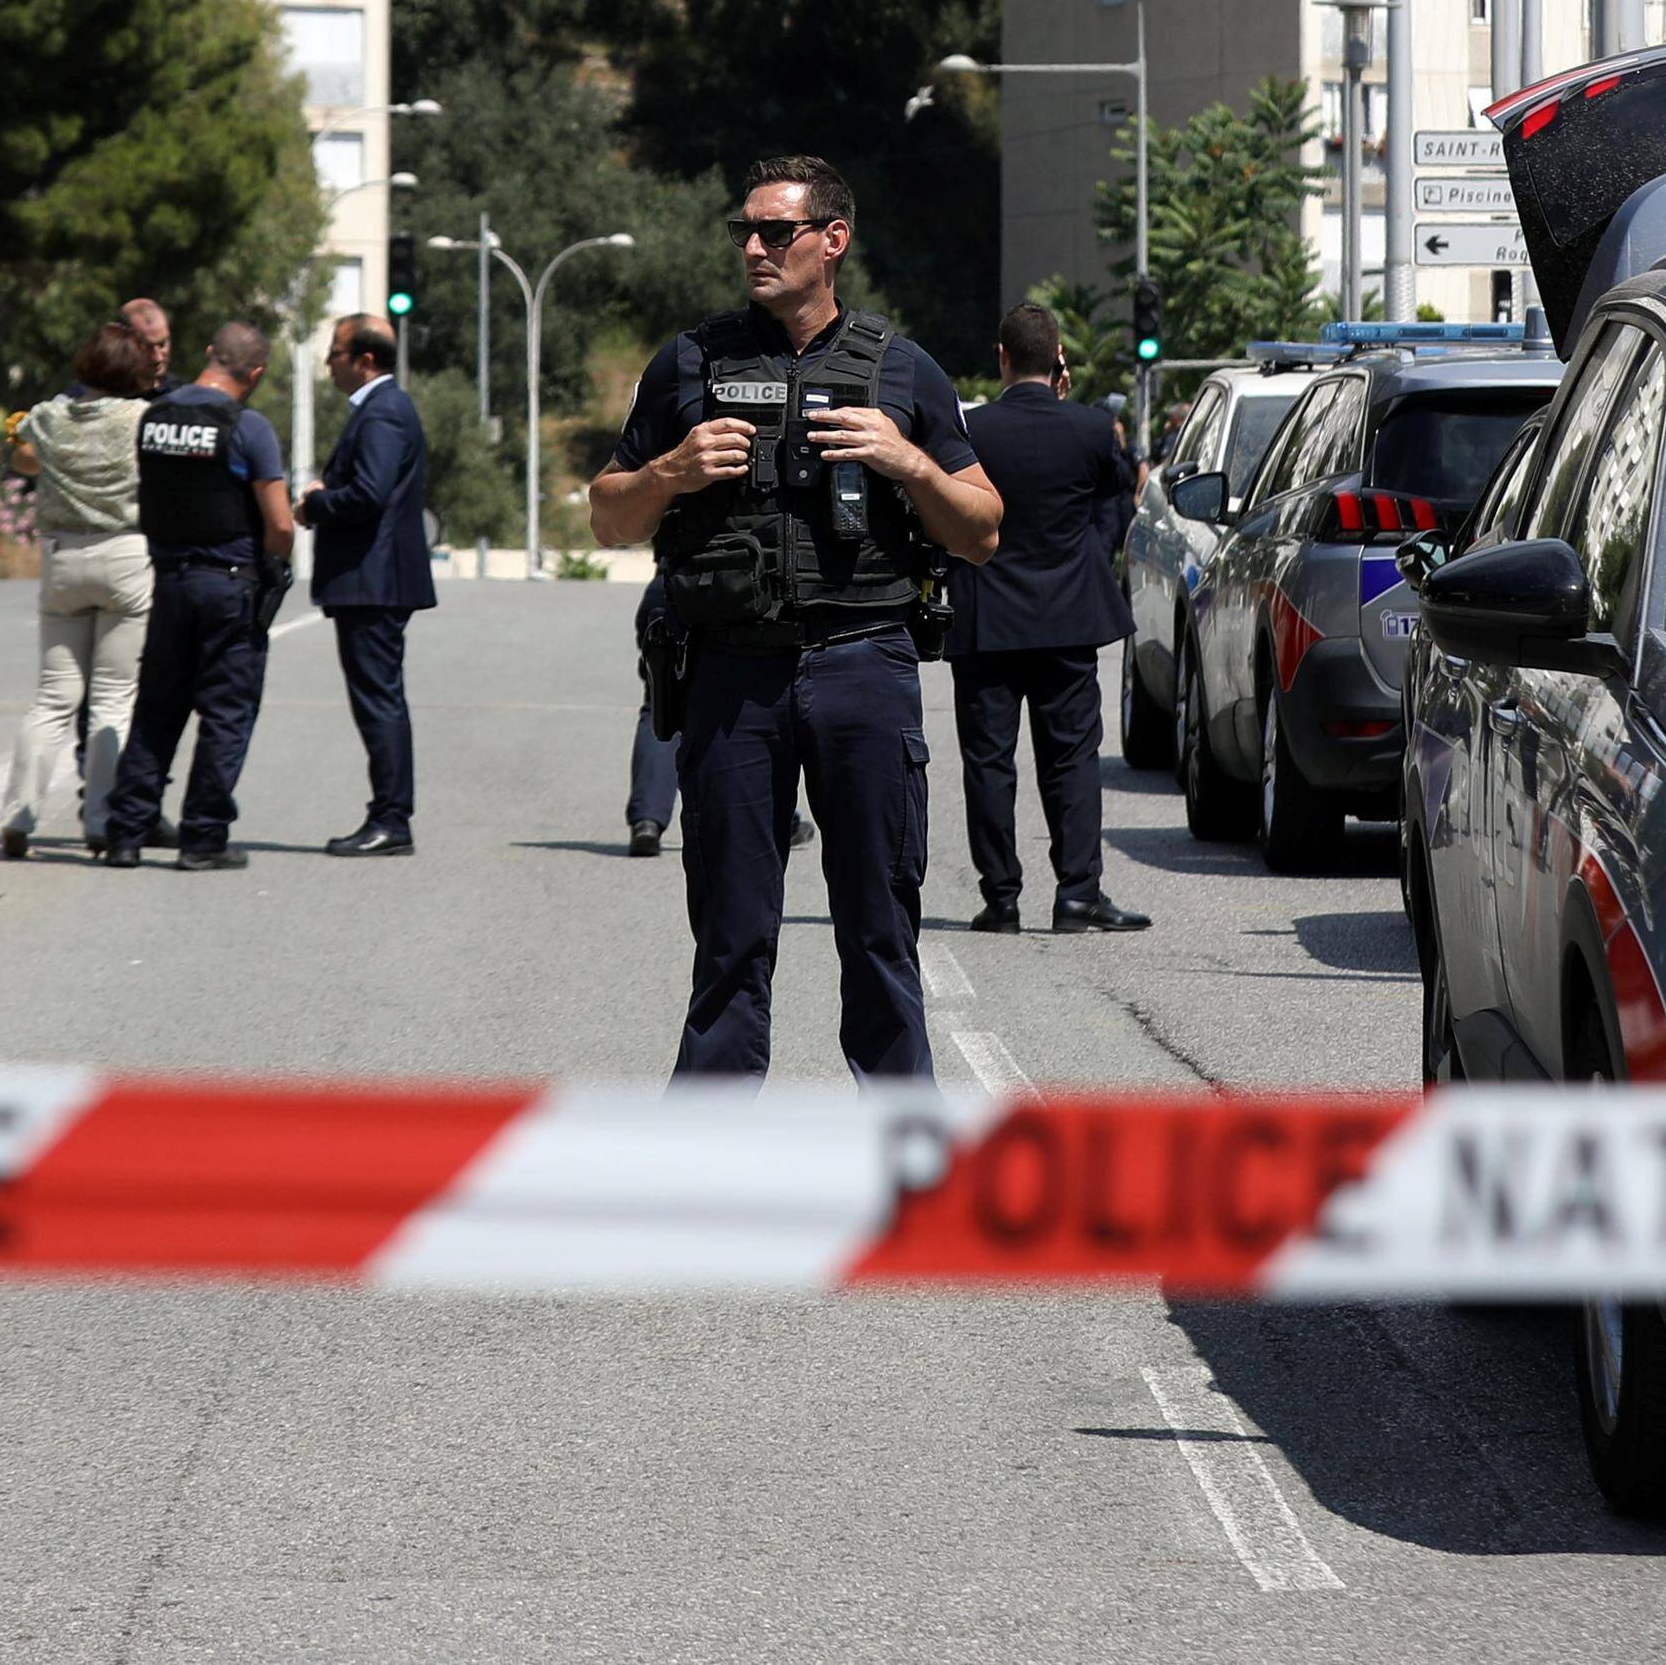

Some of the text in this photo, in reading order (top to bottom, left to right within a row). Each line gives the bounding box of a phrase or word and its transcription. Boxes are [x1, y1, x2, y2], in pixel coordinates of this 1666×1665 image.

[1424, 141, 1501, 157] SAINT-R
[1496, 245, 1529, 264] Roq
[714, 385, 786, 400] POLICE
[142, 422, 219, 449] POLICE
[879, 1108, 1375, 1250] POLICE
